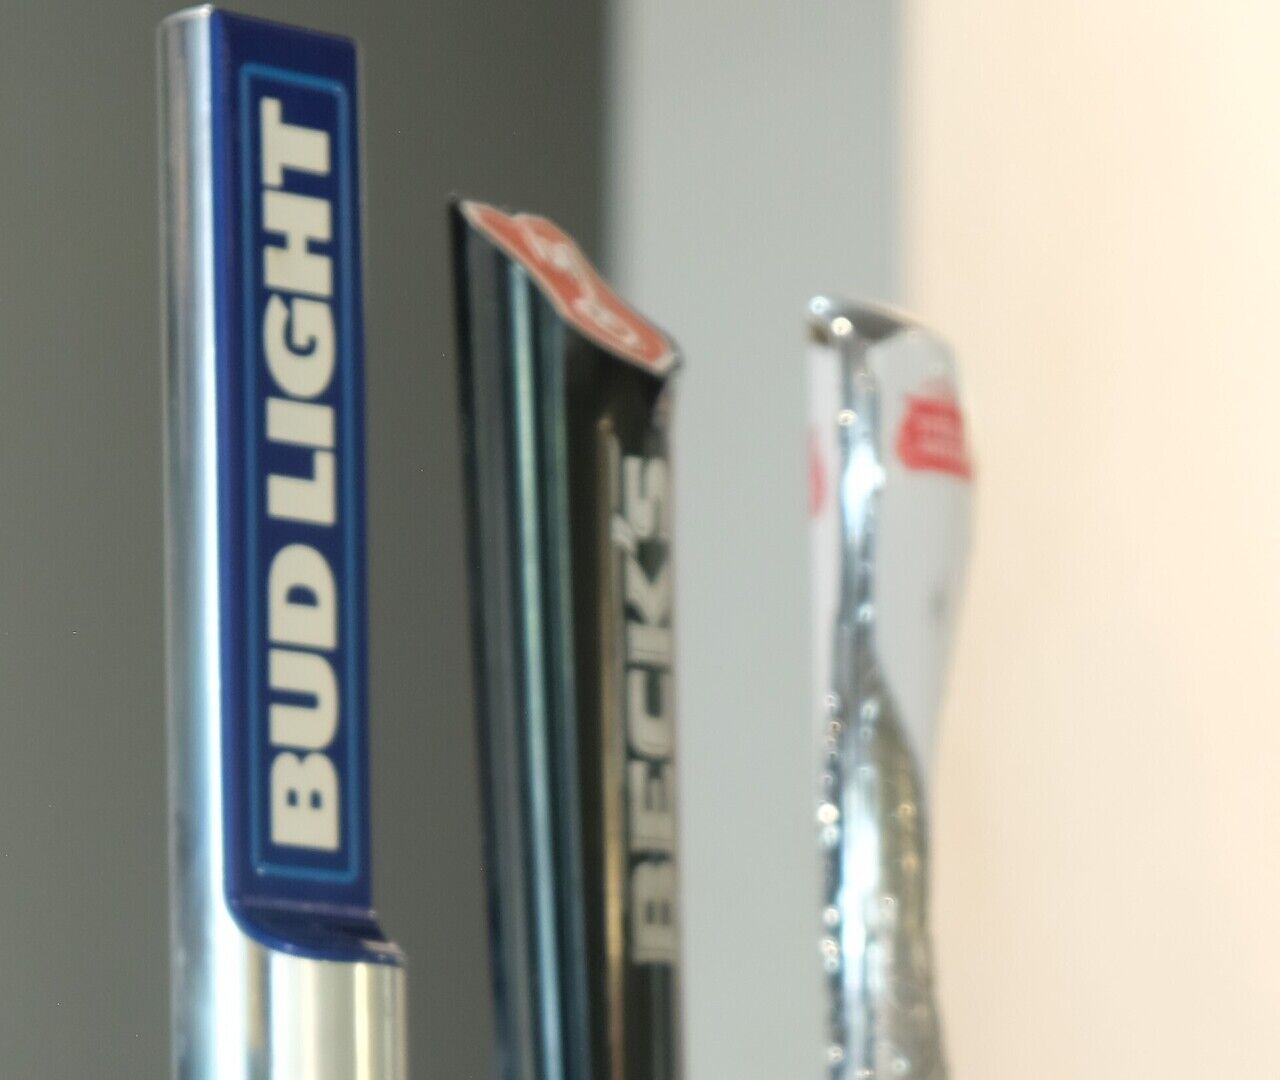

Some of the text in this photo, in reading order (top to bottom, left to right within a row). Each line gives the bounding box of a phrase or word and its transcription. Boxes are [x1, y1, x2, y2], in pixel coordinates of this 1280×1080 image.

[259, 97, 340, 851] BUD LIGHT
[611, 456, 673, 963] BECK'S
